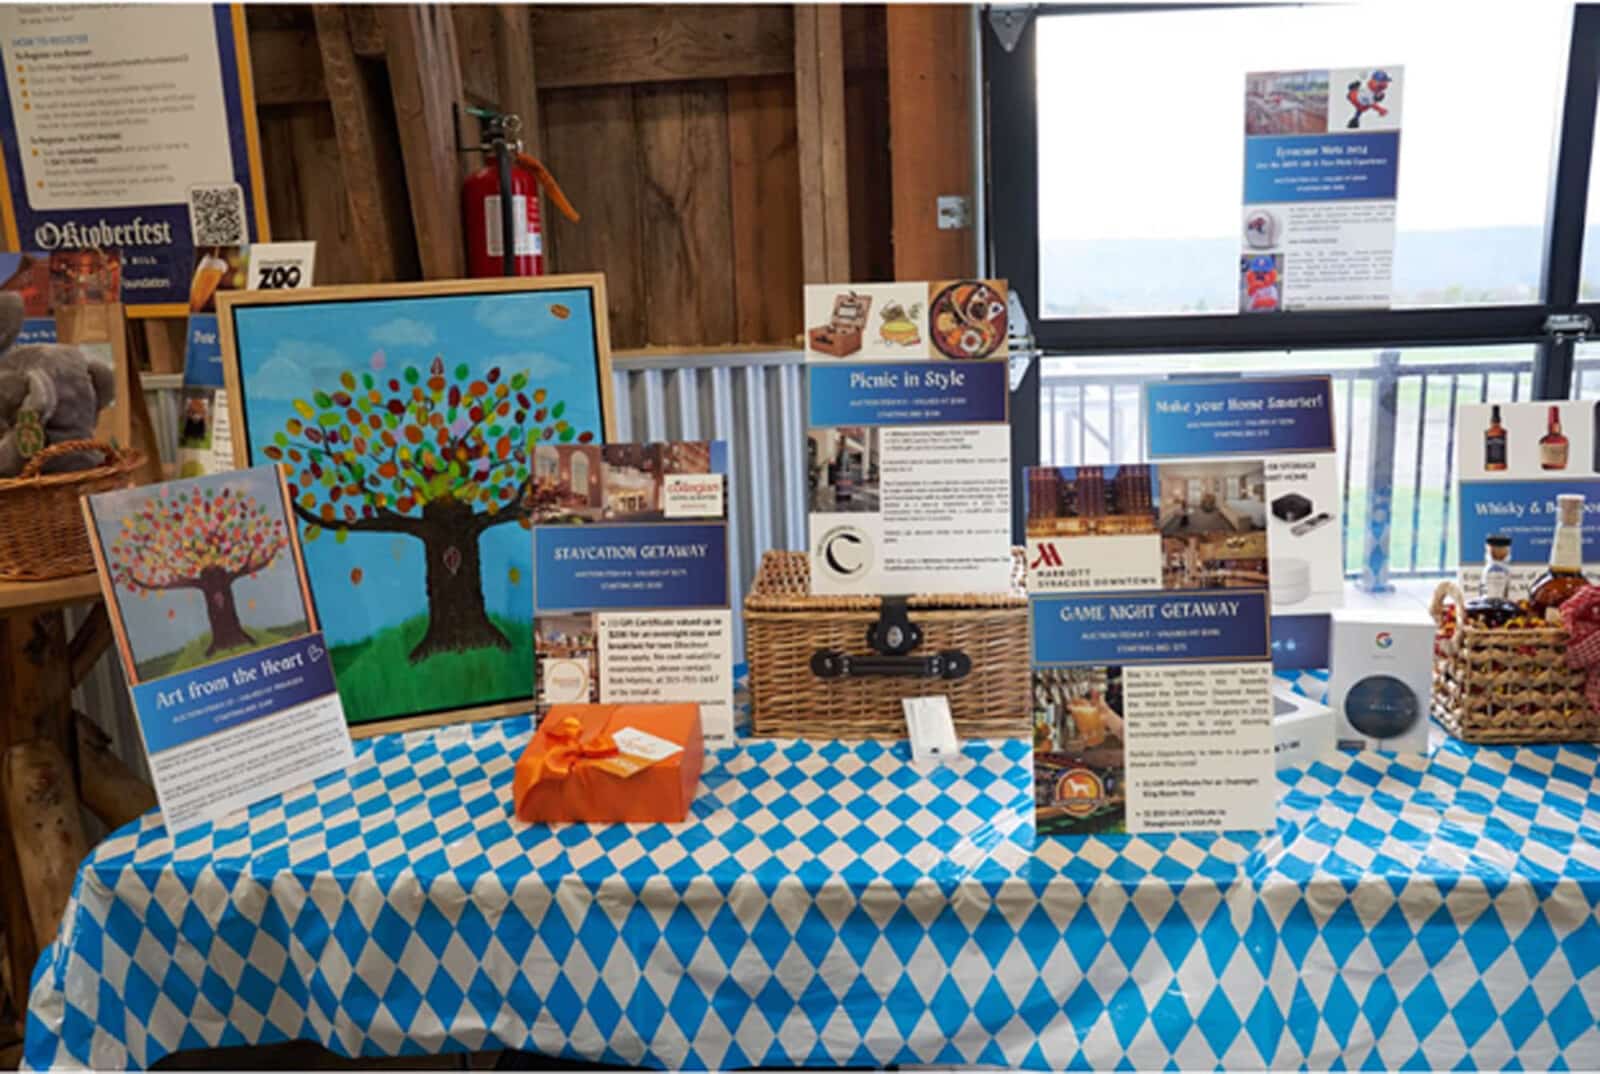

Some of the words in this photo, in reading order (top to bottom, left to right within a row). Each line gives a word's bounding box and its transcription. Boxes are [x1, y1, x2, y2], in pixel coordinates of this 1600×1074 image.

[121, 277, 170, 288] oundation
[258, 266, 302, 290] ZOO
[850, 370, 899, 389] Picnic
[904, 370, 919, 387] in
[924, 368, 966, 390] Style
[1155, 400, 1190, 414] Make
[1194, 400, 1224, 415] your
[1228, 398, 1264, 411] Home
[1267, 393, 1323, 410] Smarter!
[1474, 501, 1525, 518] Whisky
[1530, 501, 1541, 514] &
[554, 544, 637, 561] STAYCATION
[640, 543, 708, 559] GETAWAY
[1037, 568, 1091, 577] MARRIOTT
[1038, 579, 1091, 588] SYRACUSE
[1094, 577, 1157, 586] DOWNTOWN
[1060, 603, 1105, 622] GAME
[1109, 603, 1155, 621] NIGHT
[1160, 601, 1240, 619] GETAWAY
[155, 688, 185, 710] Art
[187, 676, 229, 700] from
[232, 667, 257, 687] the
[260, 651, 305, 678] Heart
